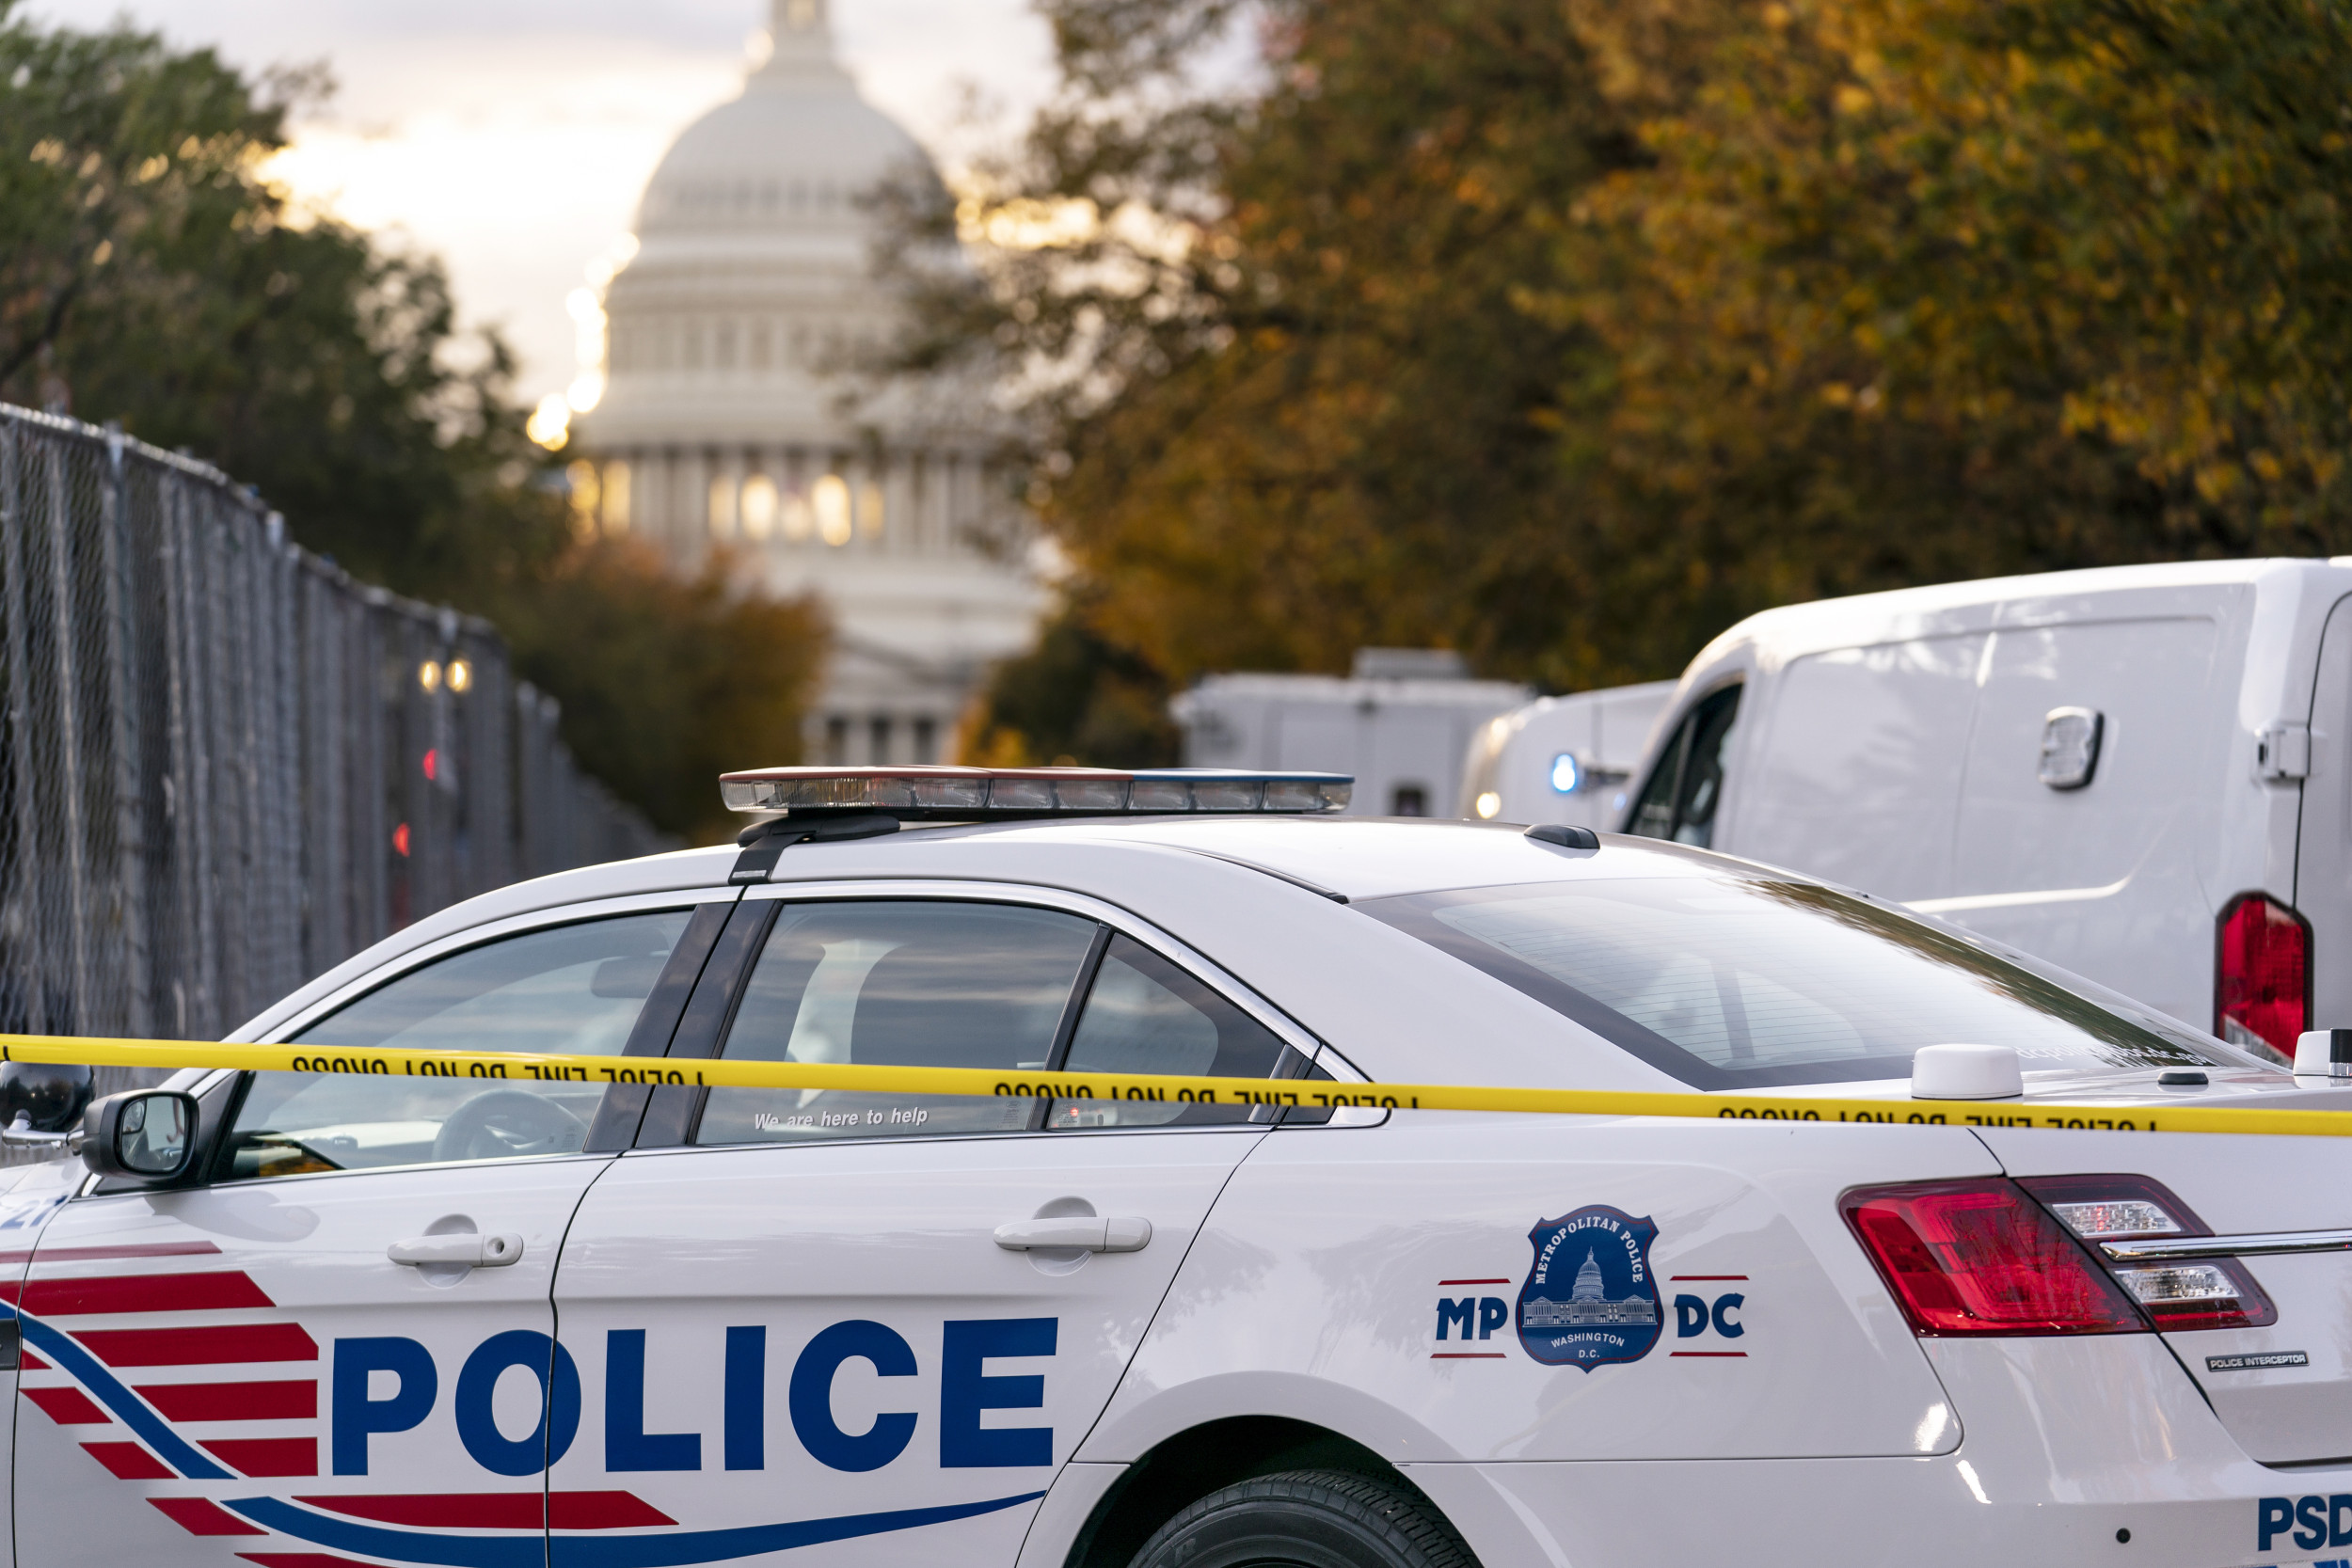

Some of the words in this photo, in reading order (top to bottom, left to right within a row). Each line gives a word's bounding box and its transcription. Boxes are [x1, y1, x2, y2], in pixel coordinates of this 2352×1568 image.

[755, 1113, 780, 1130] We
[787, 1115, 815, 1128] are
[820, 1110, 860, 1127] here
[866, 1109, 884, 1125] to
[890, 1106, 930, 1127] help
[1535, 1216, 1620, 1285] METROPOLITAN
[1620, 1230, 1644, 1283] POLICE
[1436, 1296, 1508, 1340] MP
[1673, 1292, 1745, 1338] DC
[1550, 1332, 1625, 1348] WASHINGTON
[1578, 1349, 1600, 1359] D.C.
[2211, 1357, 2243, 1369] POLICE
[2245, 1354, 2306, 1367] INTERCEPTOR
[331, 1317, 1058, 1477] POLICE
